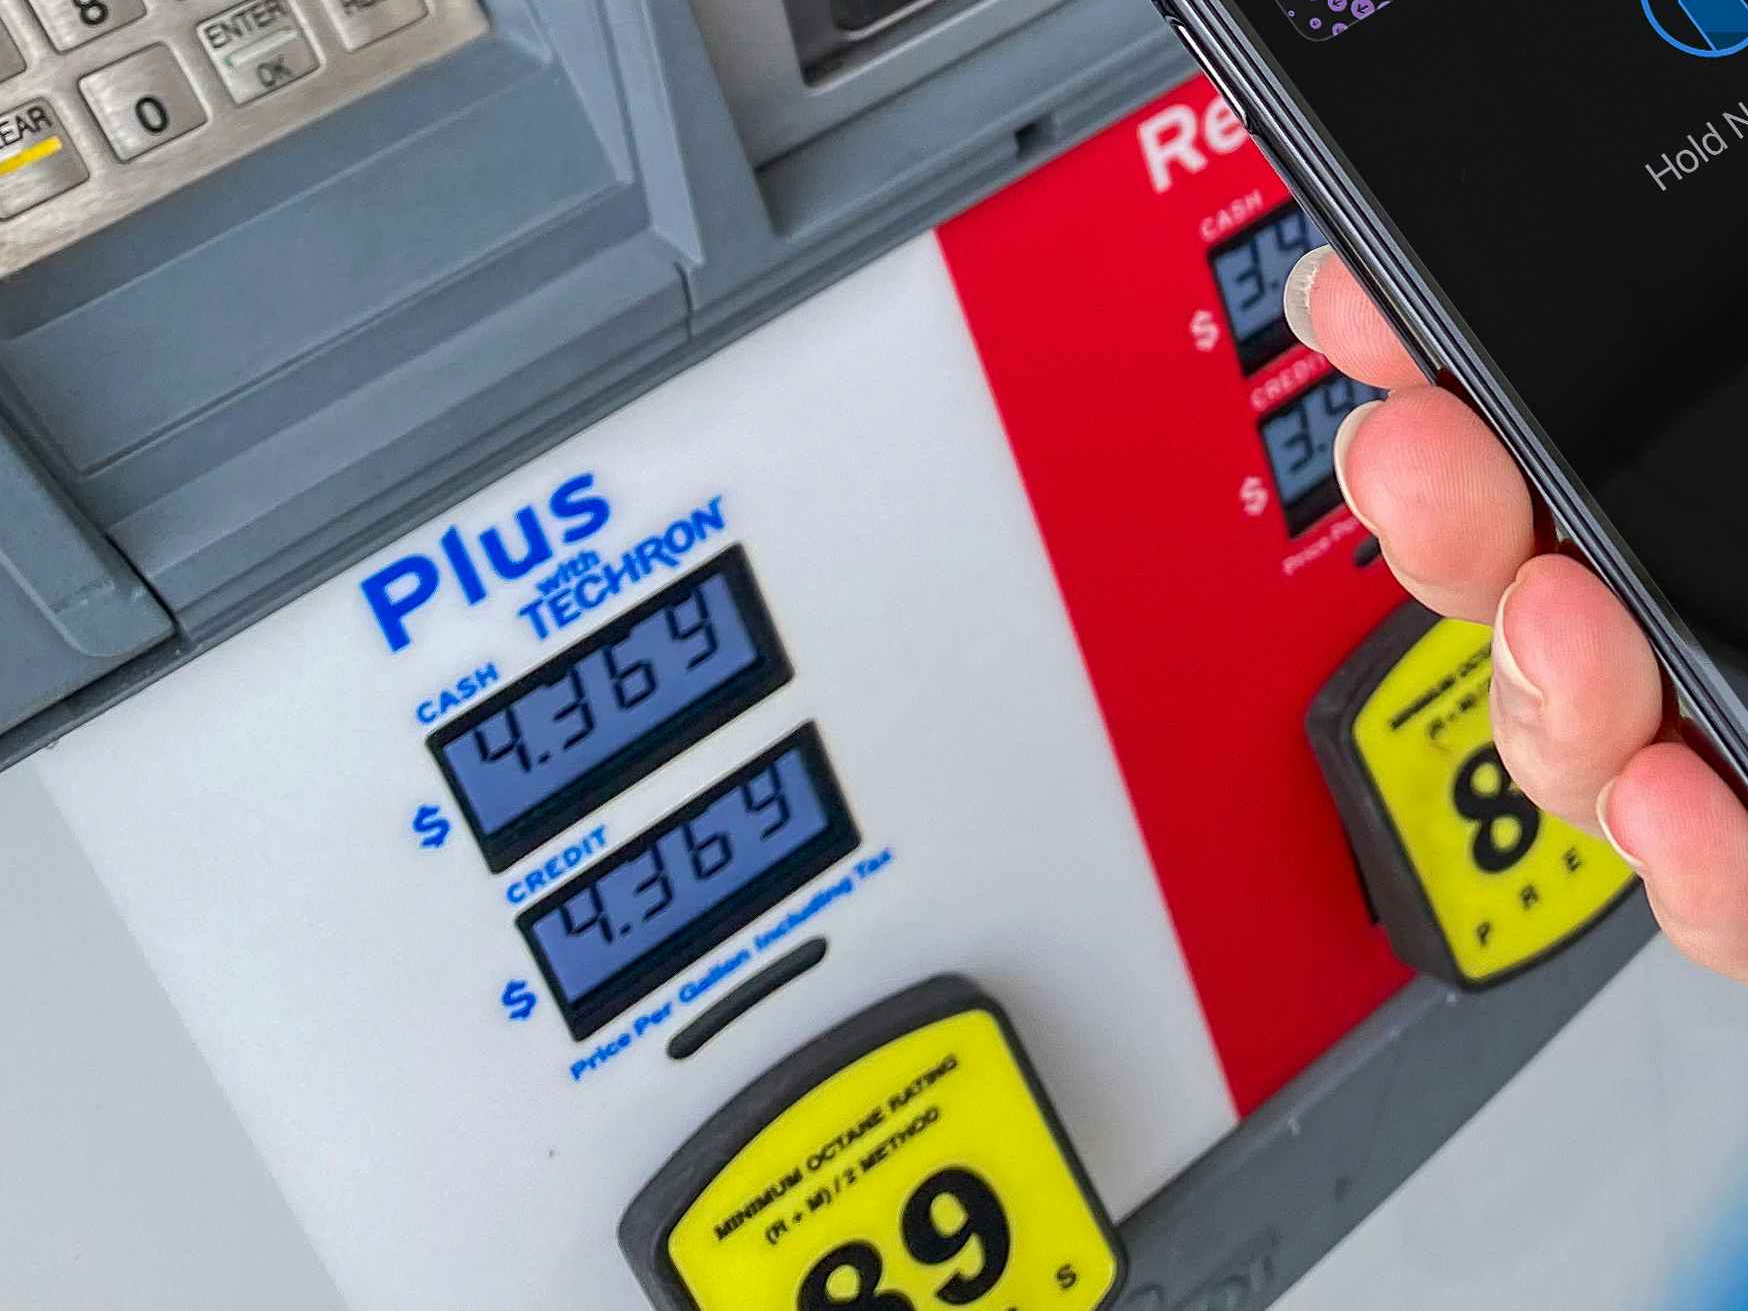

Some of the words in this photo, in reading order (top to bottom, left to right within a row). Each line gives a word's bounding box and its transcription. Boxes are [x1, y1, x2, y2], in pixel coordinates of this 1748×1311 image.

[135, 95, 169, 134] 0
[255, 54, 293, 89] OK
[0, 105, 53, 150] EAR
[1137, 96, 1249, 194] Re
[1644, 121, 1729, 191] Hold
[358, 472, 611, 652] Plus
[519, 494, 726, 640] TECHRON
[411, 804, 450, 849] $
[473, 583, 721, 774] 4.369
[416, 661, 500, 725] CASH
[501, 979, 537, 1020] $
[559, 760, 791, 945] 4.369
[505, 823, 608, 906] CREDIT
[569, 1032, 631, 1081] Price
[633, 1001, 674, 1037] Per
[677, 948, 751, 1005] Gallon
[753, 876, 853, 952] Including
[854, 847, 892, 879] Tax
[713, 1167, 803, 1241] MINIMUM
[805, 1105, 886, 1172] OCTANE
[887, 1052, 958, 1113] RATING
[859, 1105, 940, 1174] METHOD
